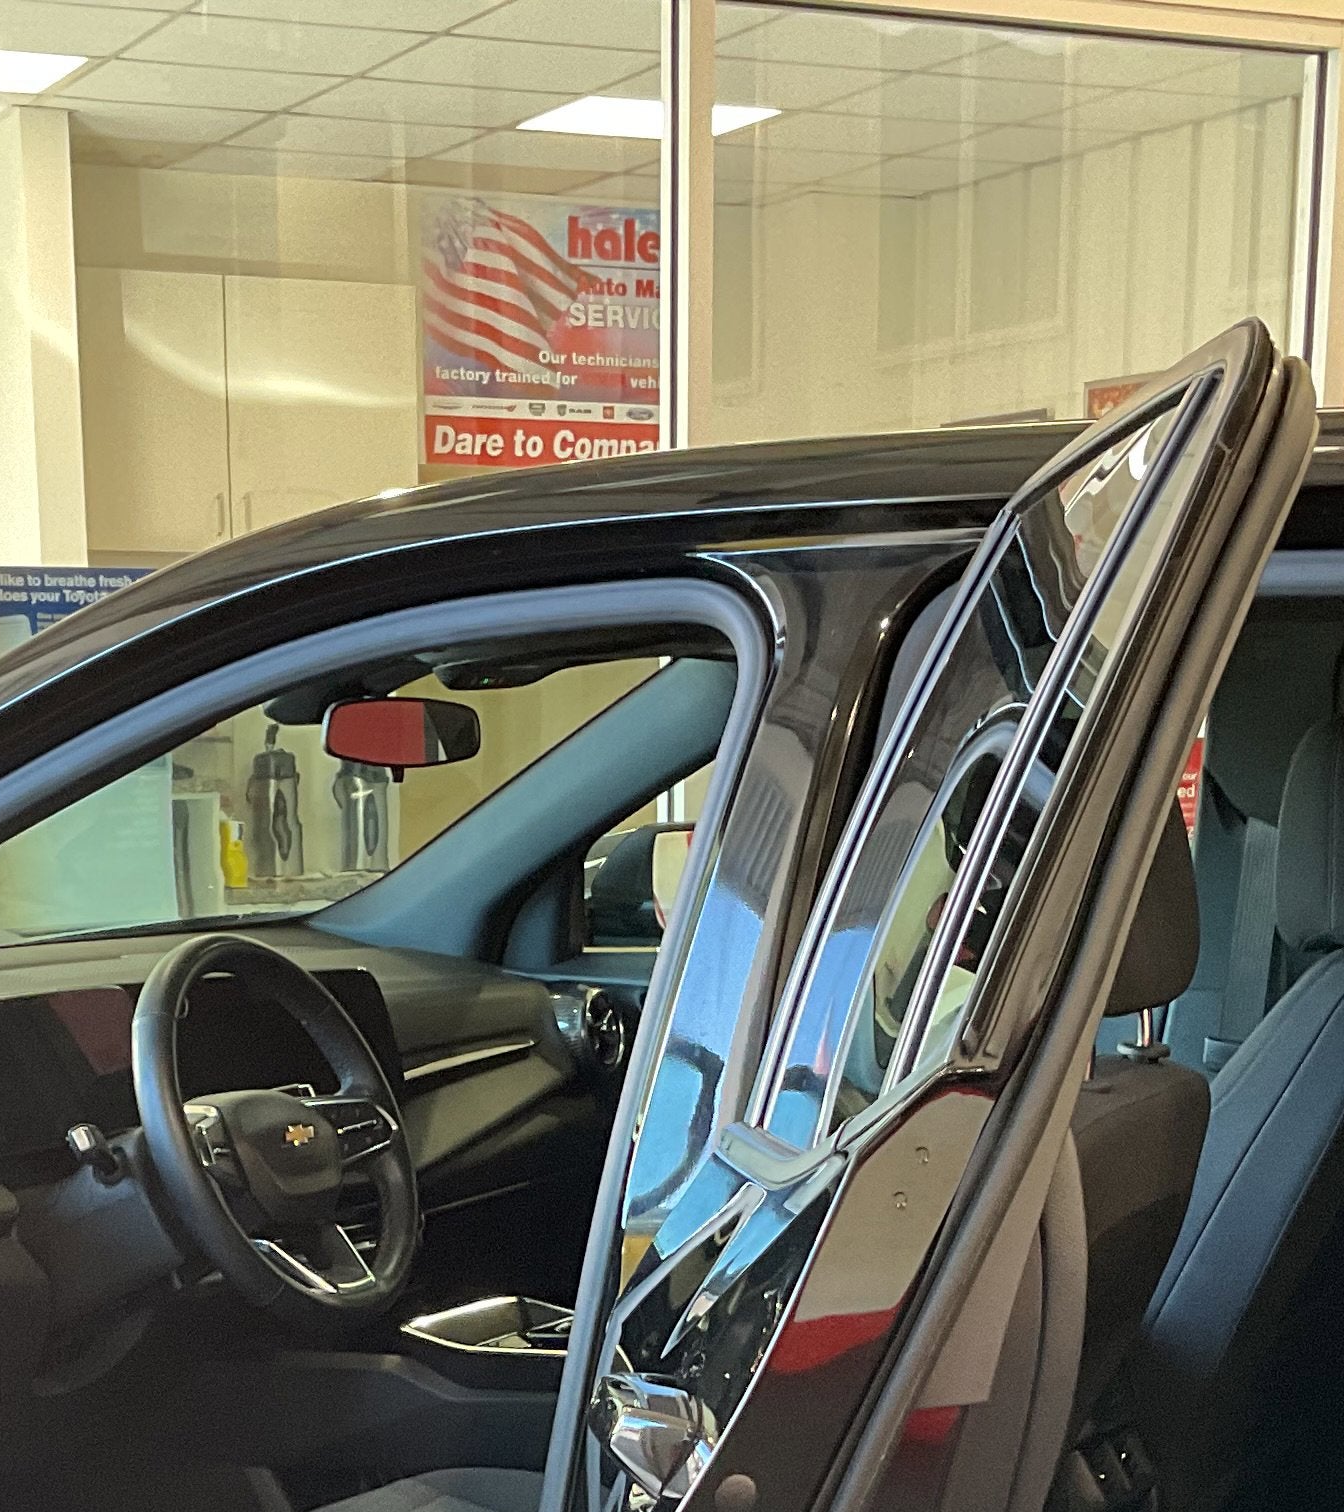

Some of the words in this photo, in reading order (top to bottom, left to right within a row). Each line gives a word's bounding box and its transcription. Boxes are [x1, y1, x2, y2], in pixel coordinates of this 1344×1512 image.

[568, 215, 660, 264] hale
[539, 350, 567, 364] Our
[572, 352, 660, 369] technicians
[435, 366, 490, 384] factory
[495, 369, 550, 385] trained
[556, 371, 578, 385] for
[434, 425, 504, 456] Dare
[514, 429, 544, 458] to
[553, 430, 660, 459] Compa
[0, 573, 25, 586] like
[27, 574, 41, 587] to
[44, 574, 96, 588] breathe
[30, 591, 61, 604] your
